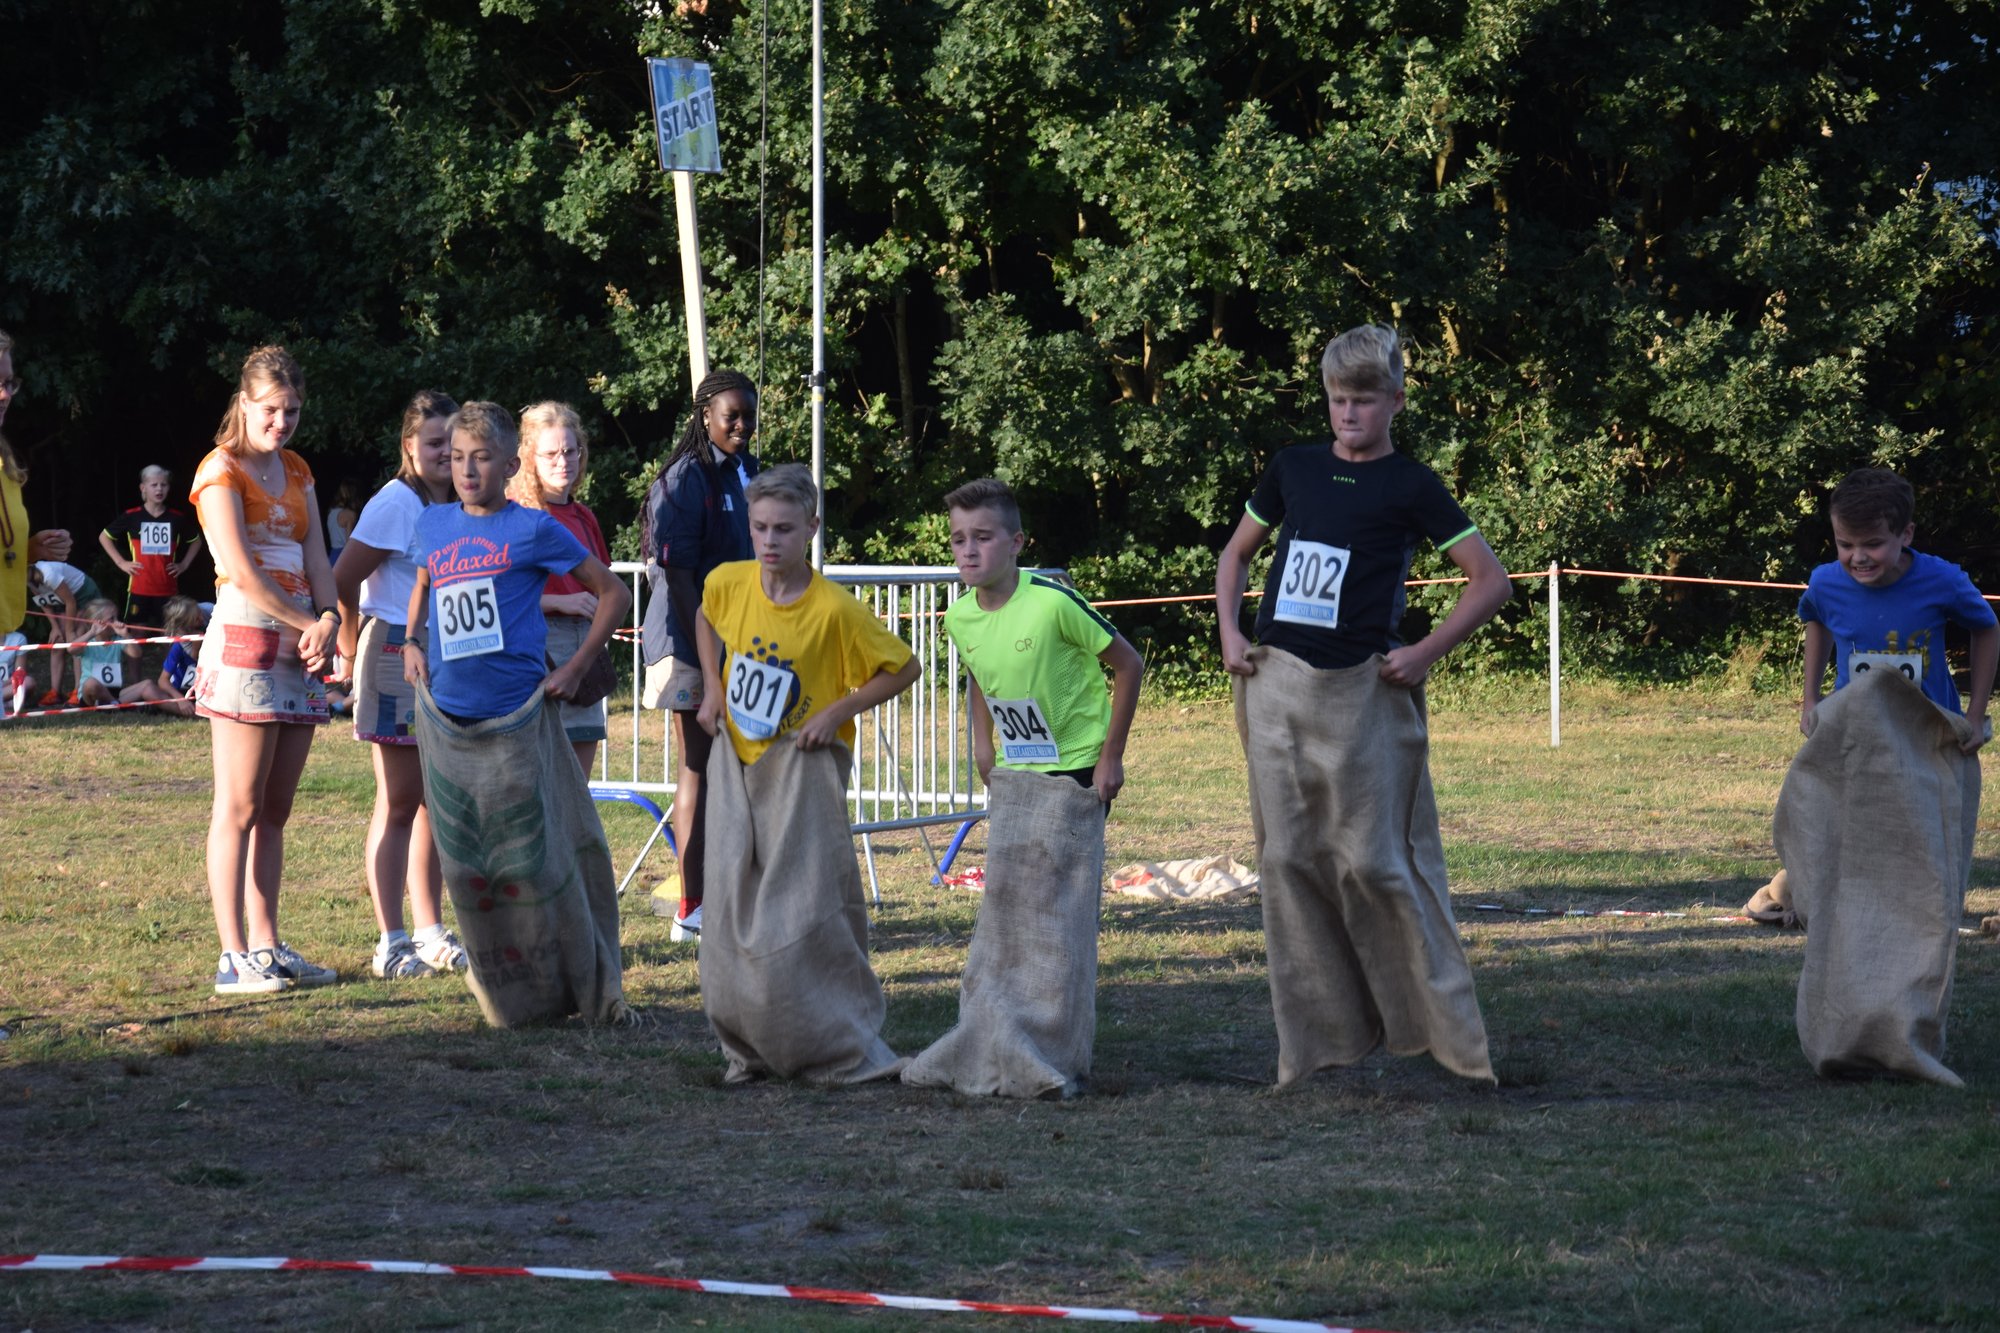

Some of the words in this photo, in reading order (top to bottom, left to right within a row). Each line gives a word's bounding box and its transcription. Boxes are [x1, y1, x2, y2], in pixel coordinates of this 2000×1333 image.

[661, 92, 712, 140] START
[143, 525, 169, 545] 166
[428, 543, 511, 577] Relaxed
[1285, 550, 1342, 601] 302
[442, 587, 495, 636] 305
[101, 665, 114, 684] 6
[731, 661, 783, 718] 301
[786, 695, 814, 728] Essen
[993, 704, 1048, 741] 304
